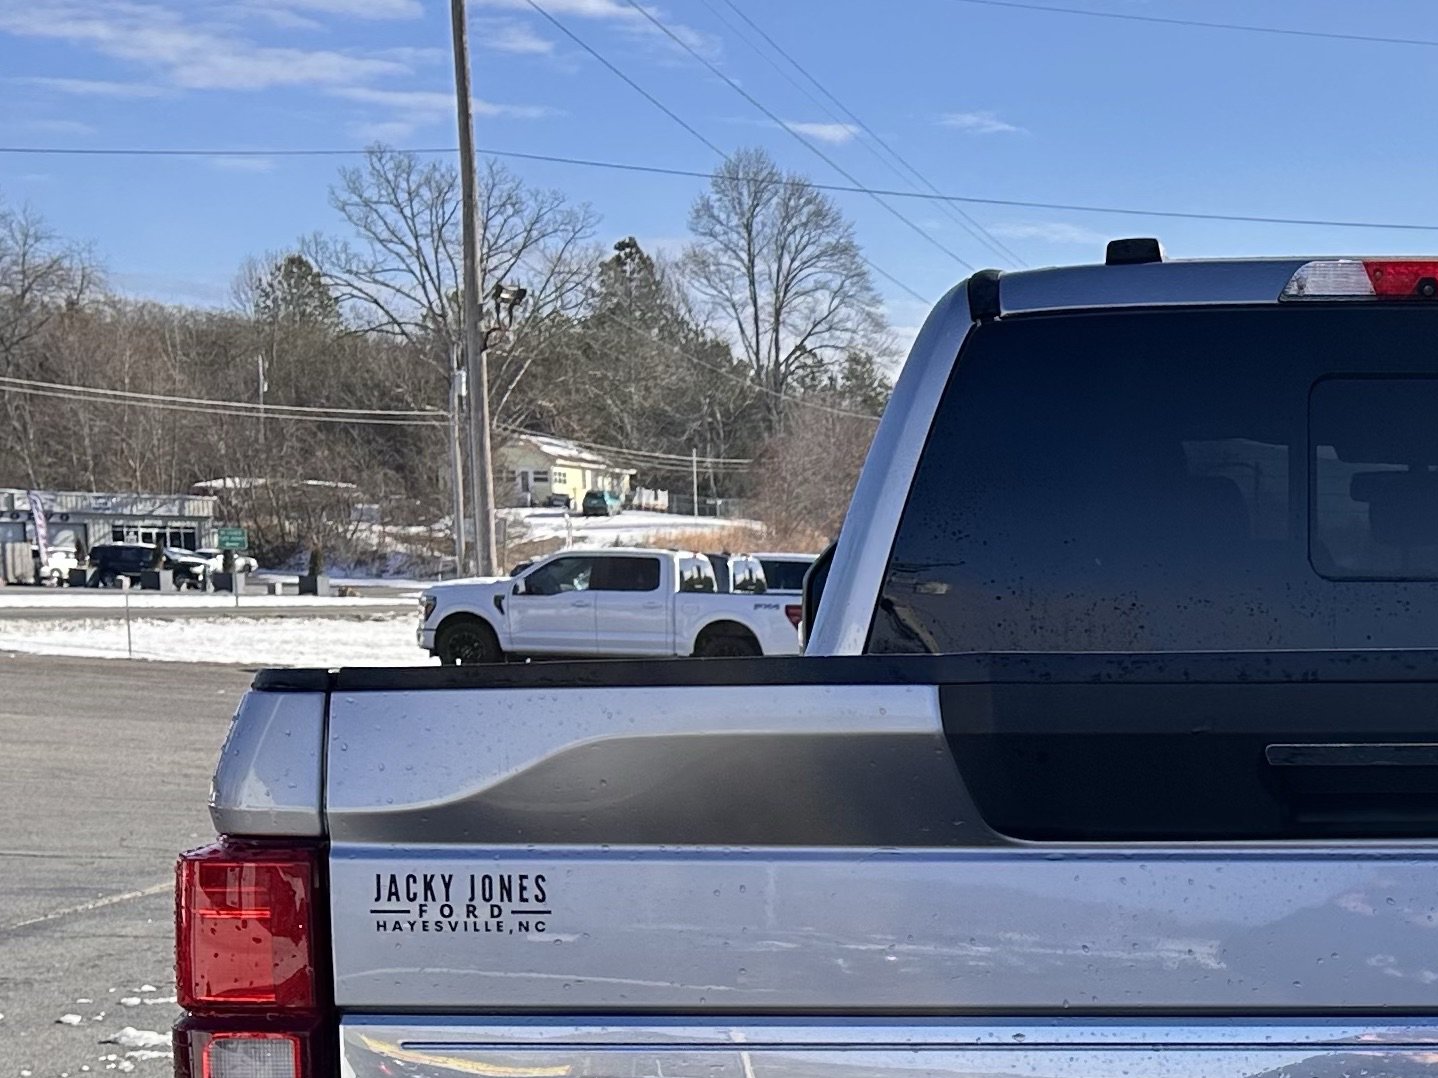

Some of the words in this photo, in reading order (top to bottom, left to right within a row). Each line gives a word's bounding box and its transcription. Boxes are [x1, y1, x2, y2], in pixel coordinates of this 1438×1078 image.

[374, 873, 454, 903] JACKY
[468, 873, 547, 903] JONES
[418, 903, 503, 919] FORD
